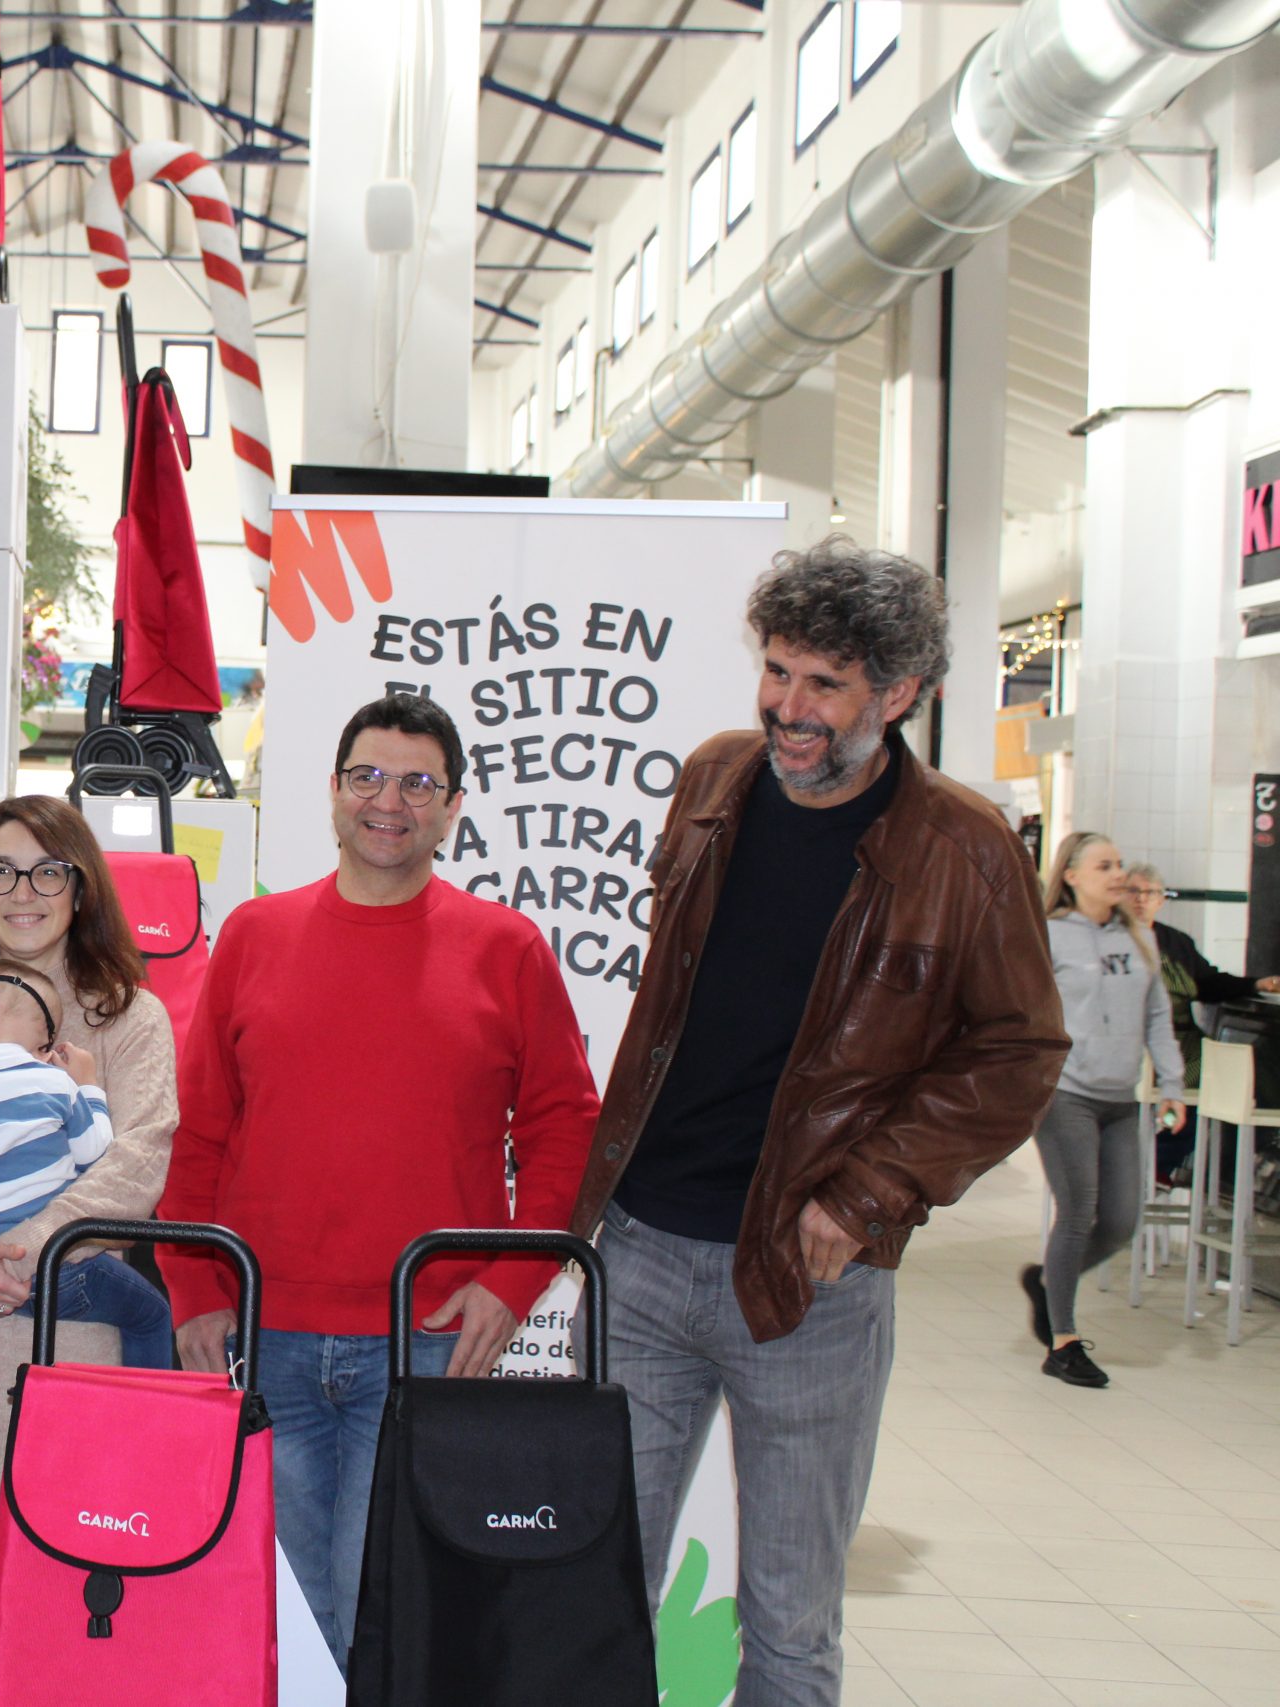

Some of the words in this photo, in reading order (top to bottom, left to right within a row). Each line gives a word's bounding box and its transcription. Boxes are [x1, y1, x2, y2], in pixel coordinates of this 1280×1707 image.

[370, 594, 560, 665] ESTÁS
[583, 602, 673, 662] EN
[471, 667, 659, 727] SITIO
[461, 732, 682, 799] FECTO
[137, 923, 171, 937] GARMOL
[78, 1511, 150, 1538] GARMOL
[486, 1505, 558, 1530] GARMOL
